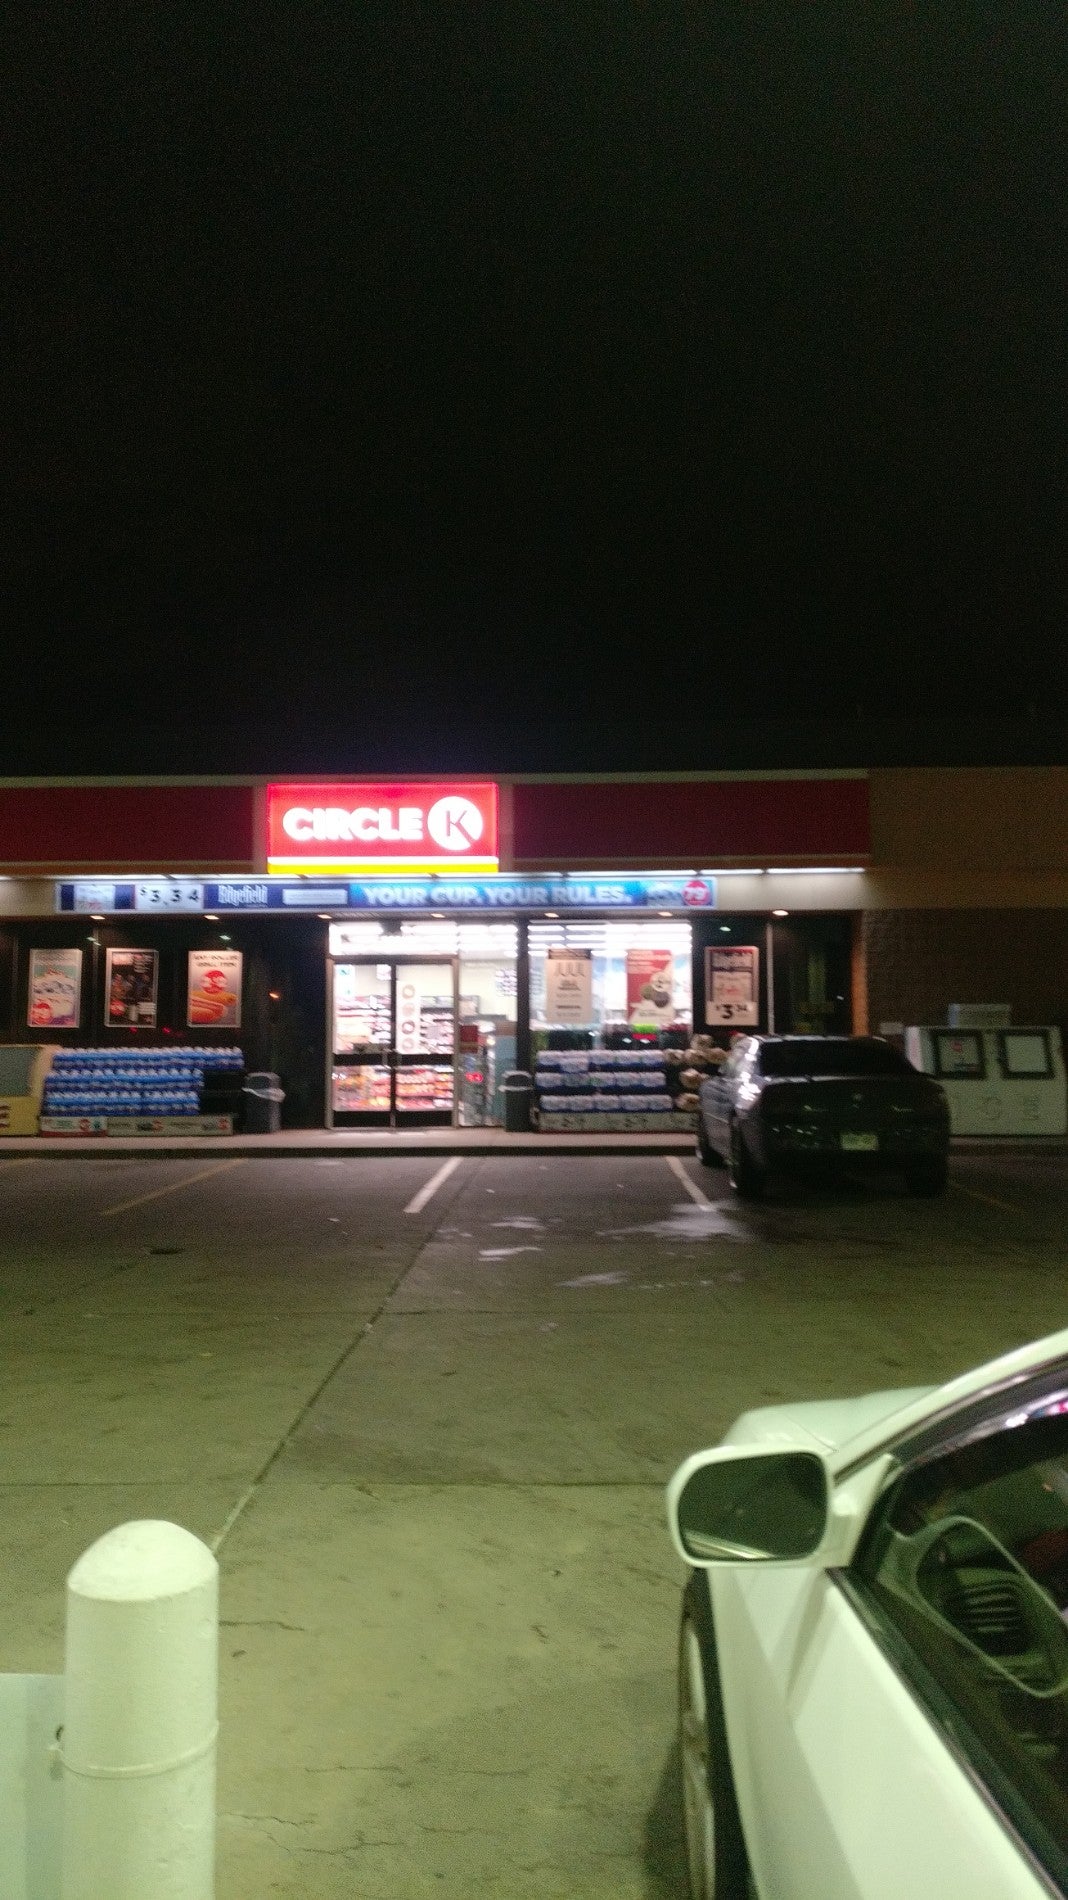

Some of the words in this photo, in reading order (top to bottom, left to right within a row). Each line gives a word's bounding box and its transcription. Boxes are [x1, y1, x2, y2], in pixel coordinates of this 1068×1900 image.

[282, 806, 424, 841] CIRCLE
[362, 886, 427, 906] YOUR
[483, 886, 550, 906] YOUR
